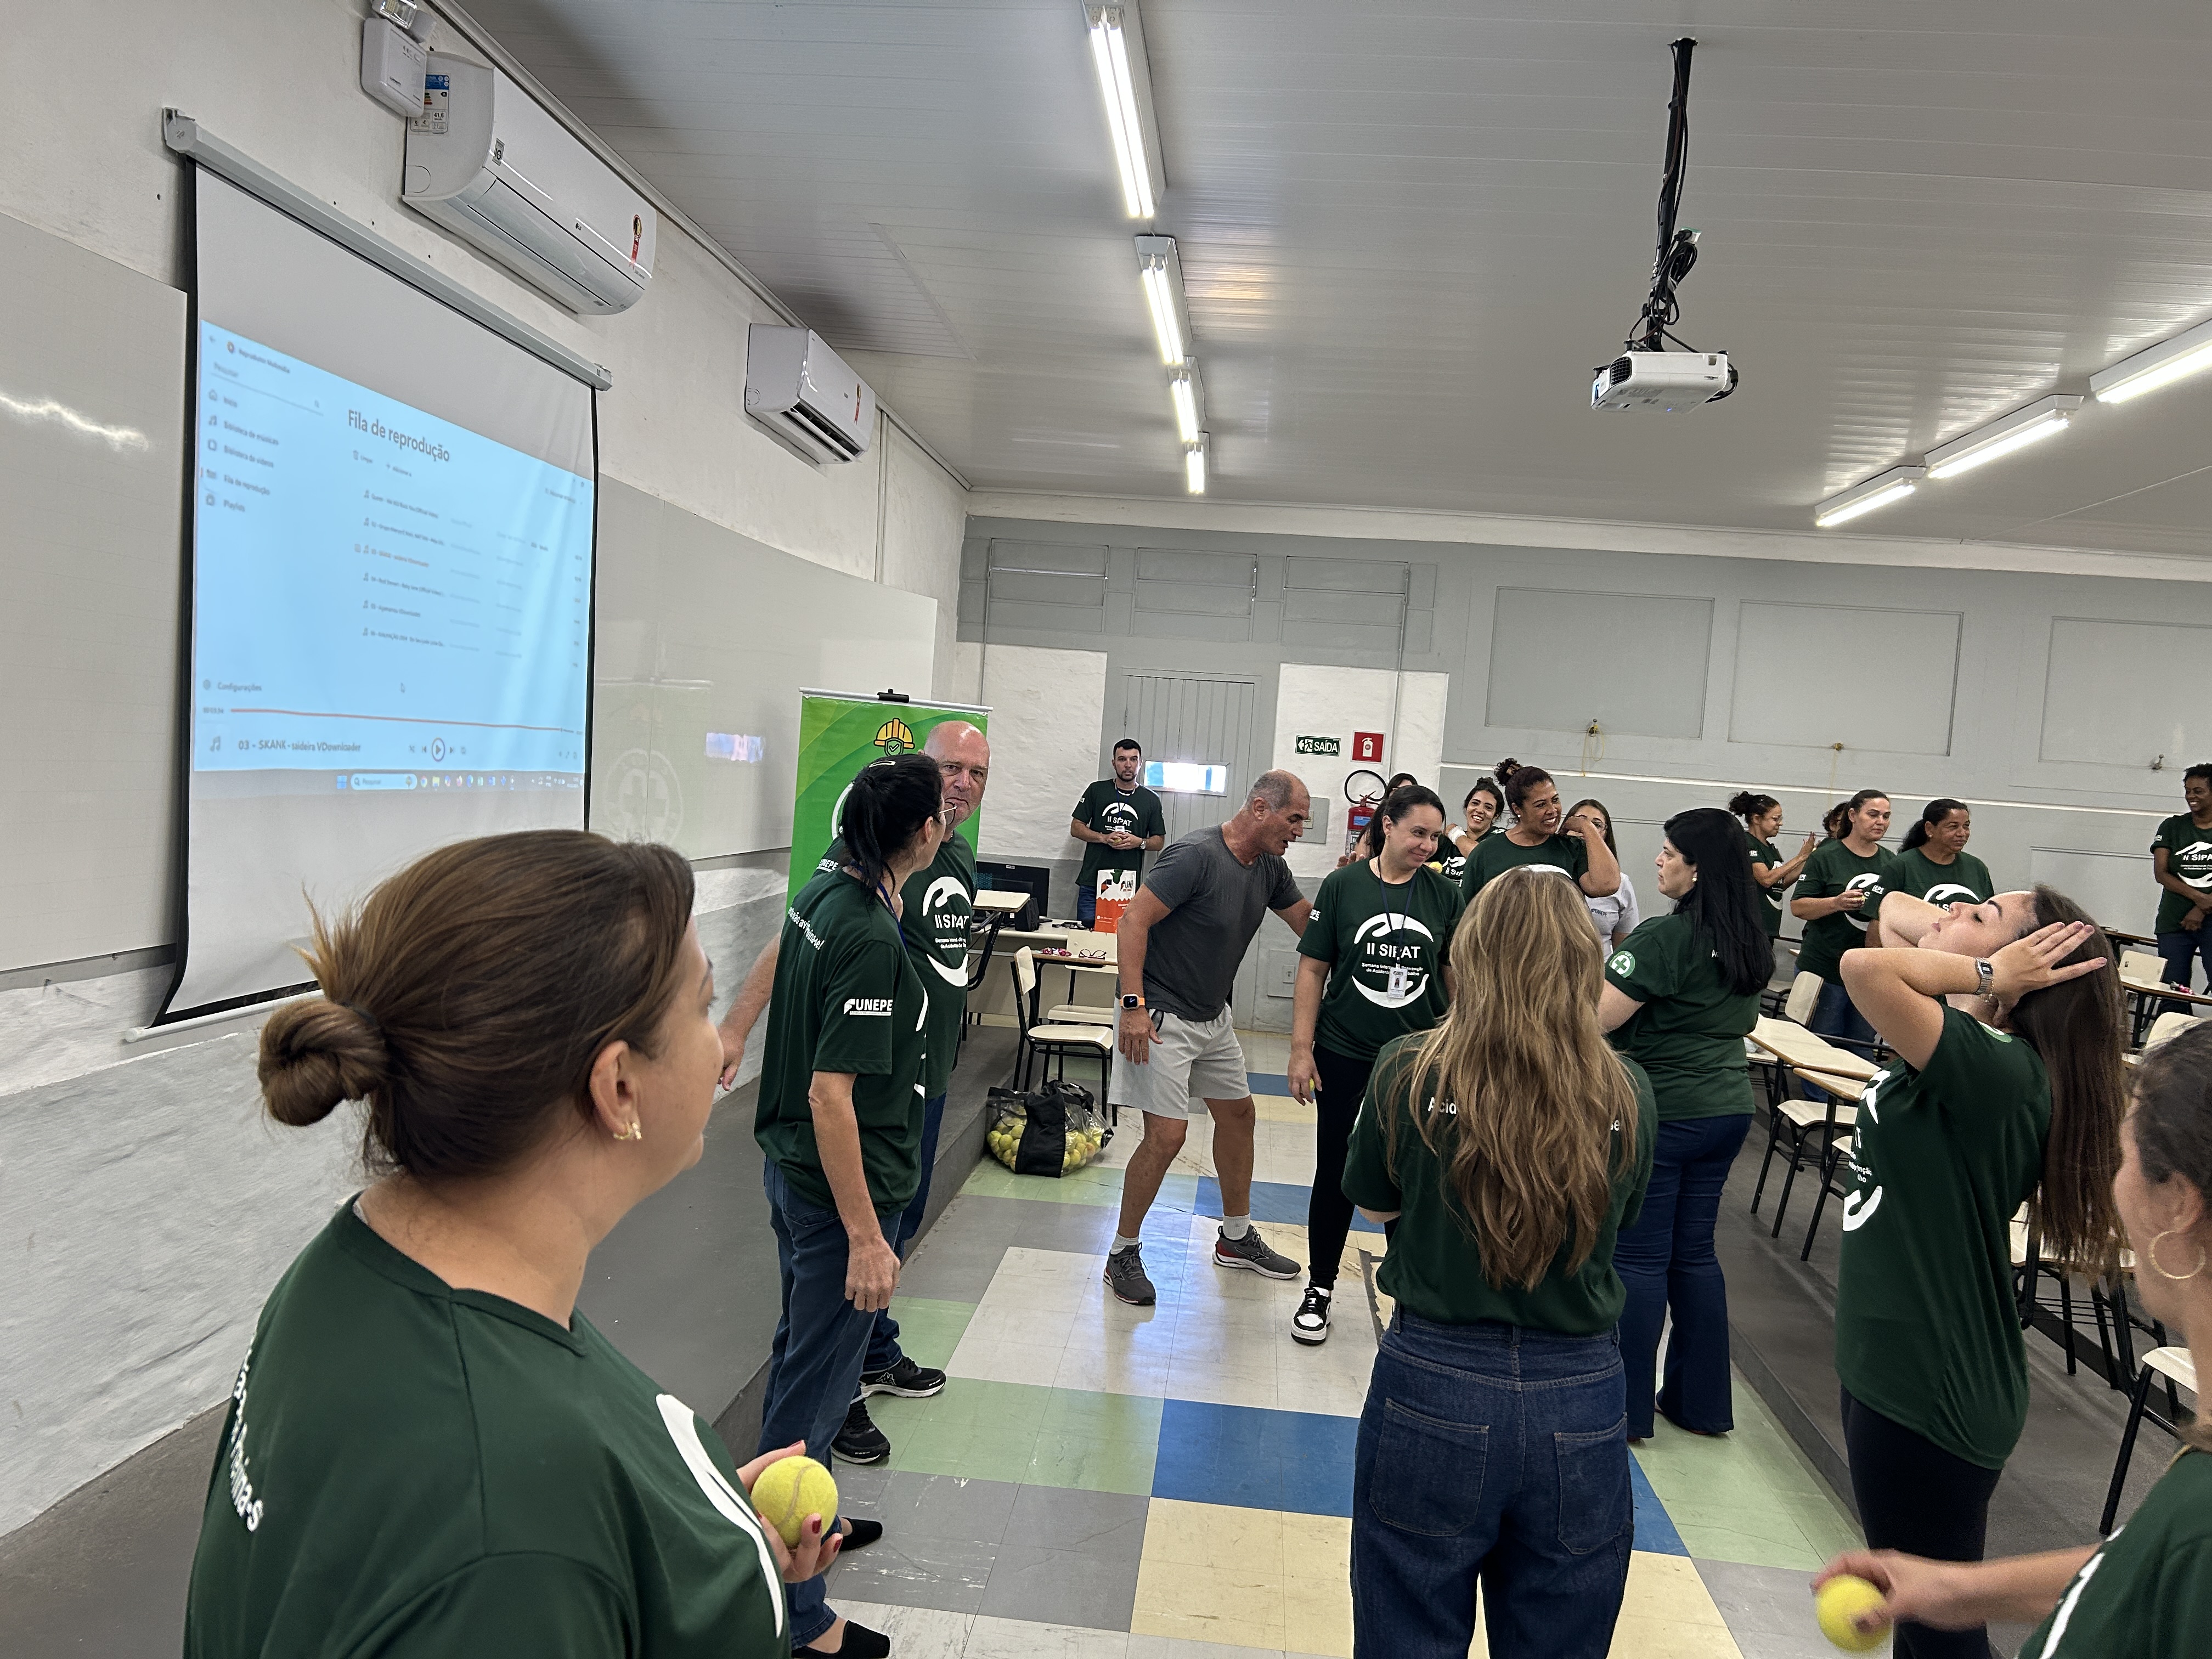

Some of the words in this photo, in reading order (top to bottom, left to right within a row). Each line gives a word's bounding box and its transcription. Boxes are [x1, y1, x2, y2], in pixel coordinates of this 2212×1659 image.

[348, 409, 368, 432] Fila
[371, 419, 386, 438] de
[388, 427, 450, 462] reprodução
[238, 740, 249, 750] 03
[258, 740, 286, 751] SKANK
[1314, 740, 1338, 753] SAÍDA
[1367, 942, 1375, 955] II
